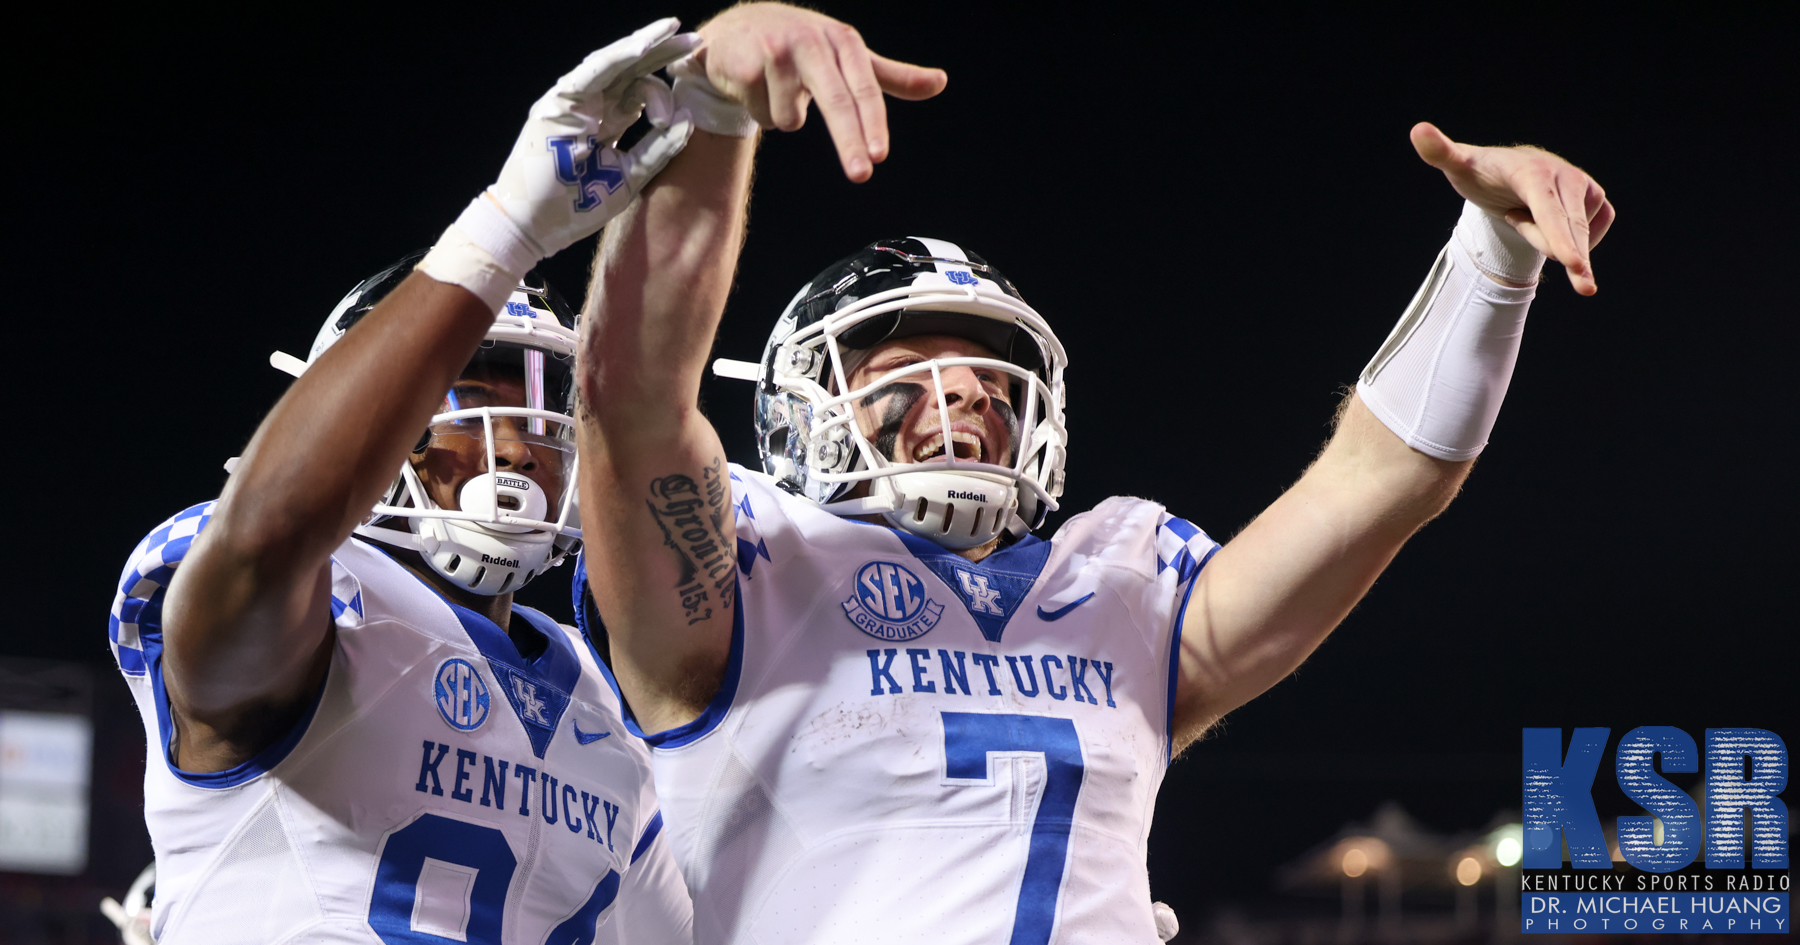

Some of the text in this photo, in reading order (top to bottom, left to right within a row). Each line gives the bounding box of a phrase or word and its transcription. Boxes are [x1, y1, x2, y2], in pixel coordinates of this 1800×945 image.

[546, 134, 624, 212] UK
[497, 478, 527, 489] BATTLE
[947, 489, 986, 503] Riddell
[481, 553, 520, 569] Riddell
[650, 473, 737, 609] Chronicles
[679, 582, 713, 626] 15:7
[860, 562, 922, 620] SEC
[955, 568, 1005, 617] UK
[855, 611, 934, 640] GRADUATE
[439, 662, 486, 726] SEC
[511, 674, 552, 728] UK
[866, 647, 1117, 709] KENTUCKY
[415, 739, 620, 853] KENTUCKY
[939, 711, 1085, 945] 7
